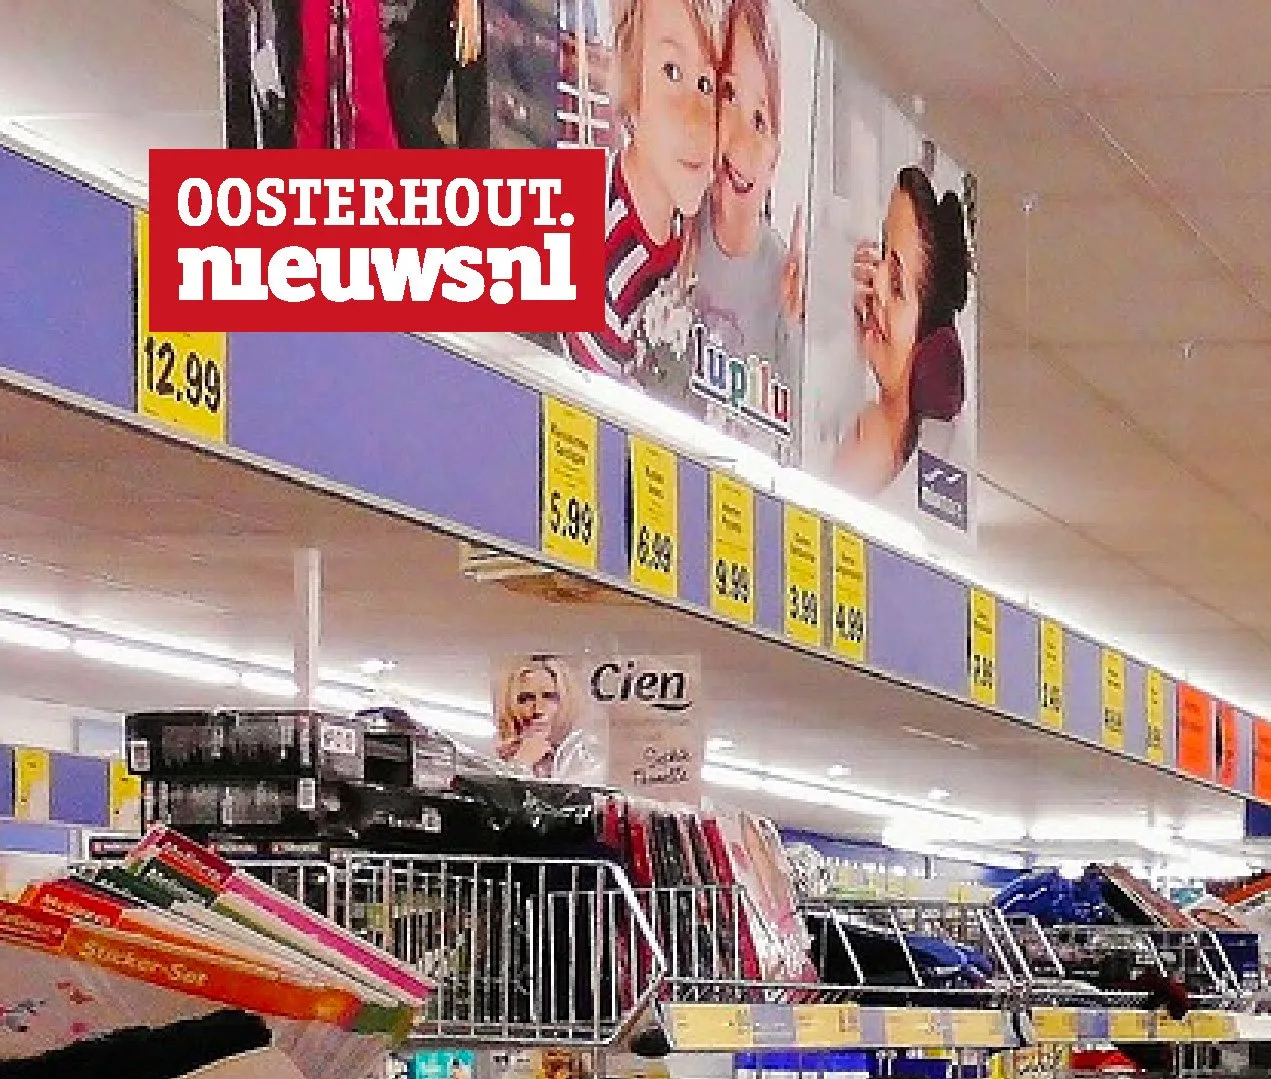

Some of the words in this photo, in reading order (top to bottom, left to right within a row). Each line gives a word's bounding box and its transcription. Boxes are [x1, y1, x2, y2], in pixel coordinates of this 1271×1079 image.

[143, 336, 222, 414] 12.99
[550, 489, 593, 546] 5.99
[636, 524, 671, 574] 6.99
[715, 557, 749, 605] 9.99
[591, 661, 685, 702] Cien
